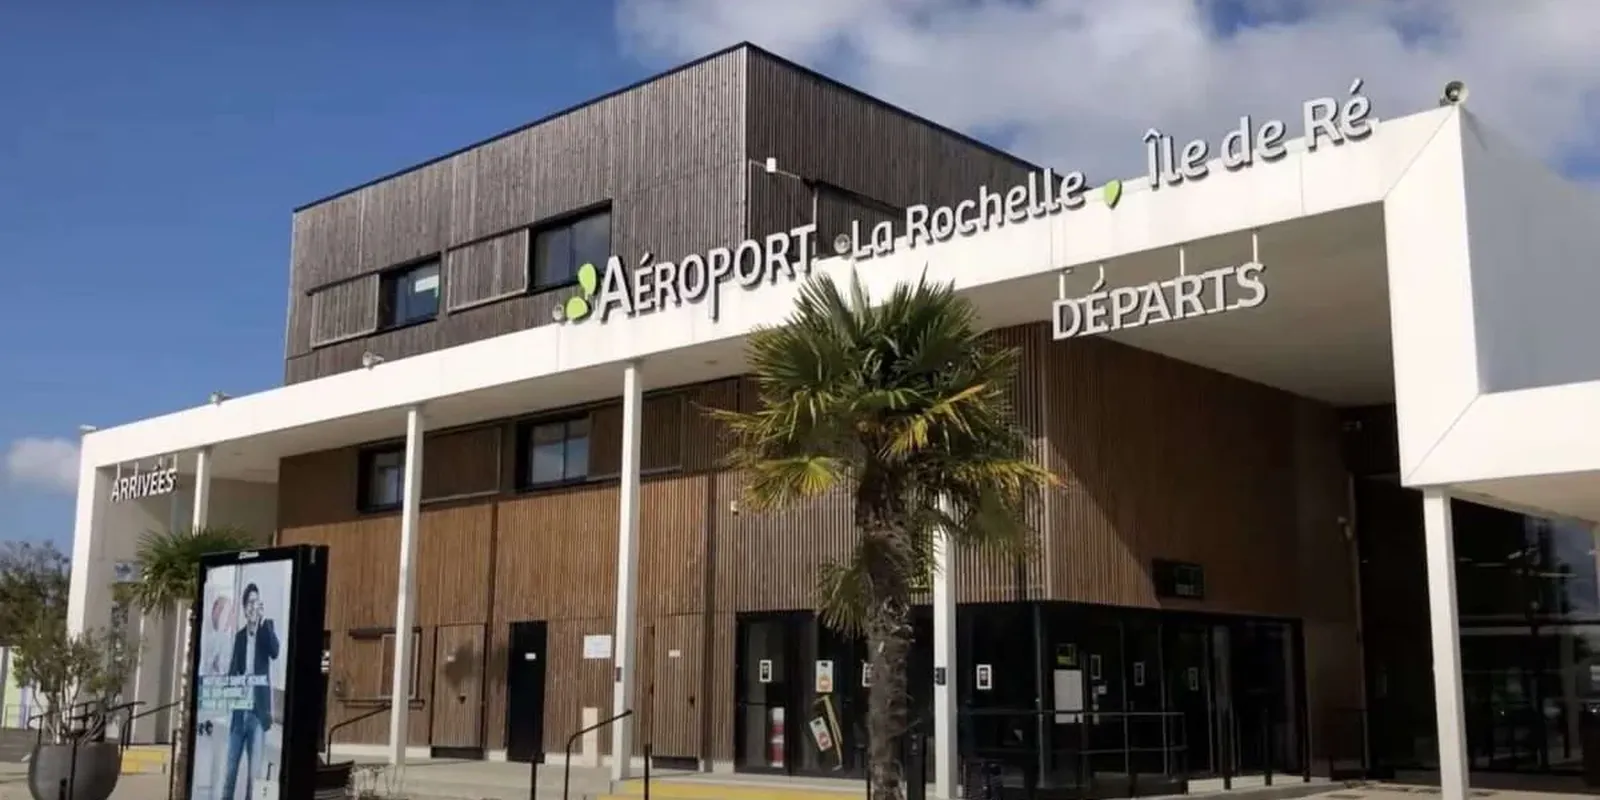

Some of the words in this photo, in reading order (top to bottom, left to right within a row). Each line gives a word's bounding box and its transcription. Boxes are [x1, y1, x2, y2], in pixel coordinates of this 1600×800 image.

[600, 224, 817, 323] AÉROPORT
[852, 220, 895, 260] La
[906, 168, 1086, 248] Rochelle
[1143, 127, 1210, 189] Île
[1220, 115, 1287, 170] de
[1303, 78, 1374, 151] Ré
[1052, 262, 1267, 340] DÉPARTS
[110, 465, 177, 503] ARRIVÉES
